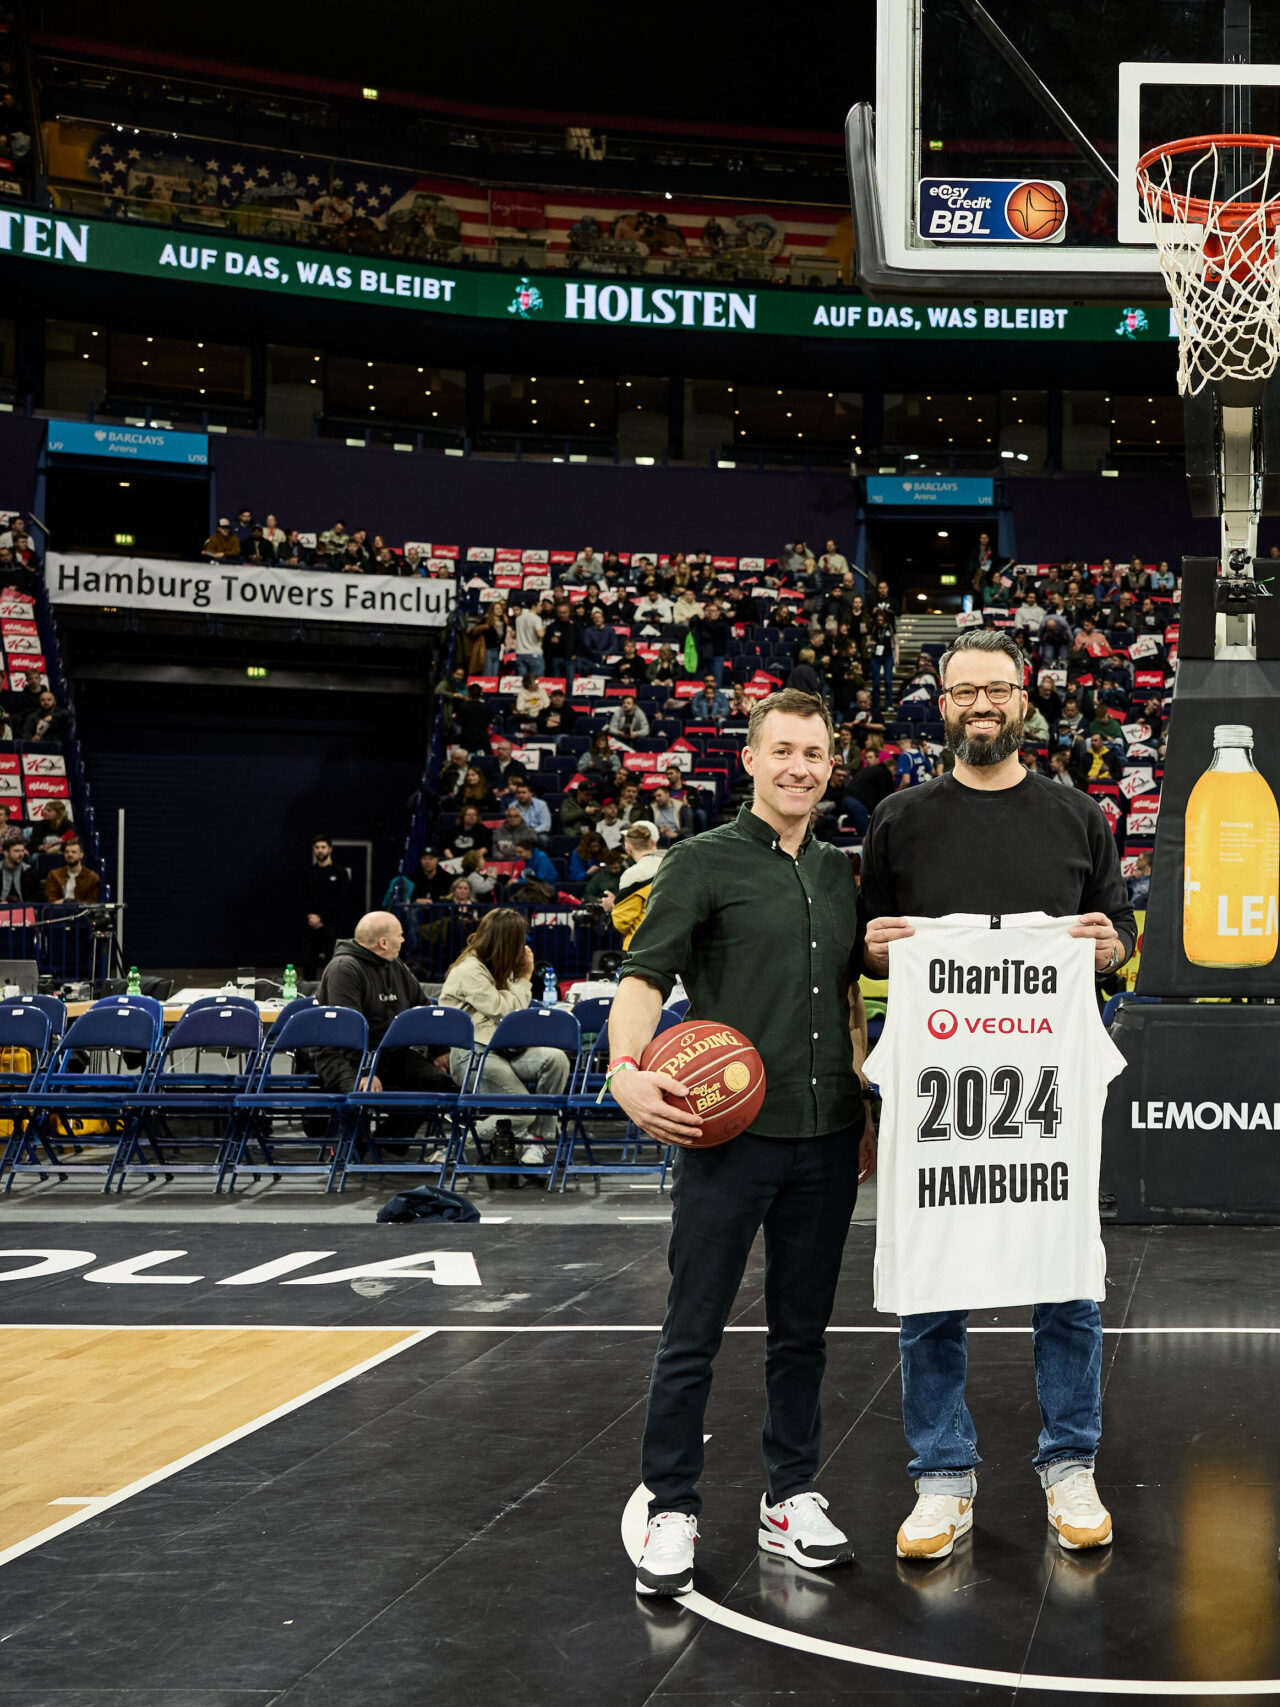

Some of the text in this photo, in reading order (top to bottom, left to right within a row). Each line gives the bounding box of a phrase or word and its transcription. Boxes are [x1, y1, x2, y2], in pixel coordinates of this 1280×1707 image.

[948, 194, 992, 210] Credit
[929, 210, 991, 235] BBL
[159, 244, 455, 302] AUF DAS, WAS BLEIBT
[565, 283, 757, 329] HOLSTEN
[813, 306, 1068, 331] AUF DAS, WAS BLEIBT
[48, 441, 63, 450] U9
[108, 431, 164, 446] BARCLAYS
[108, 443, 137, 454] Arena
[188, 453, 207, 463] U10
[913, 482, 958, 491] BARCLAYS
[913, 493, 937, 501] Arena
[57, 564, 211, 607] Hamburg
[221, 575, 333, 608] Towers
[929, 958, 1058, 995] ChariTea
[965, 1017, 1053, 1034] VEOLIA
[696, 1090, 726, 1112] BBL
[917, 1065, 1063, 1143] 2024
[918, 1161, 1069, 1208] HAMBURG
